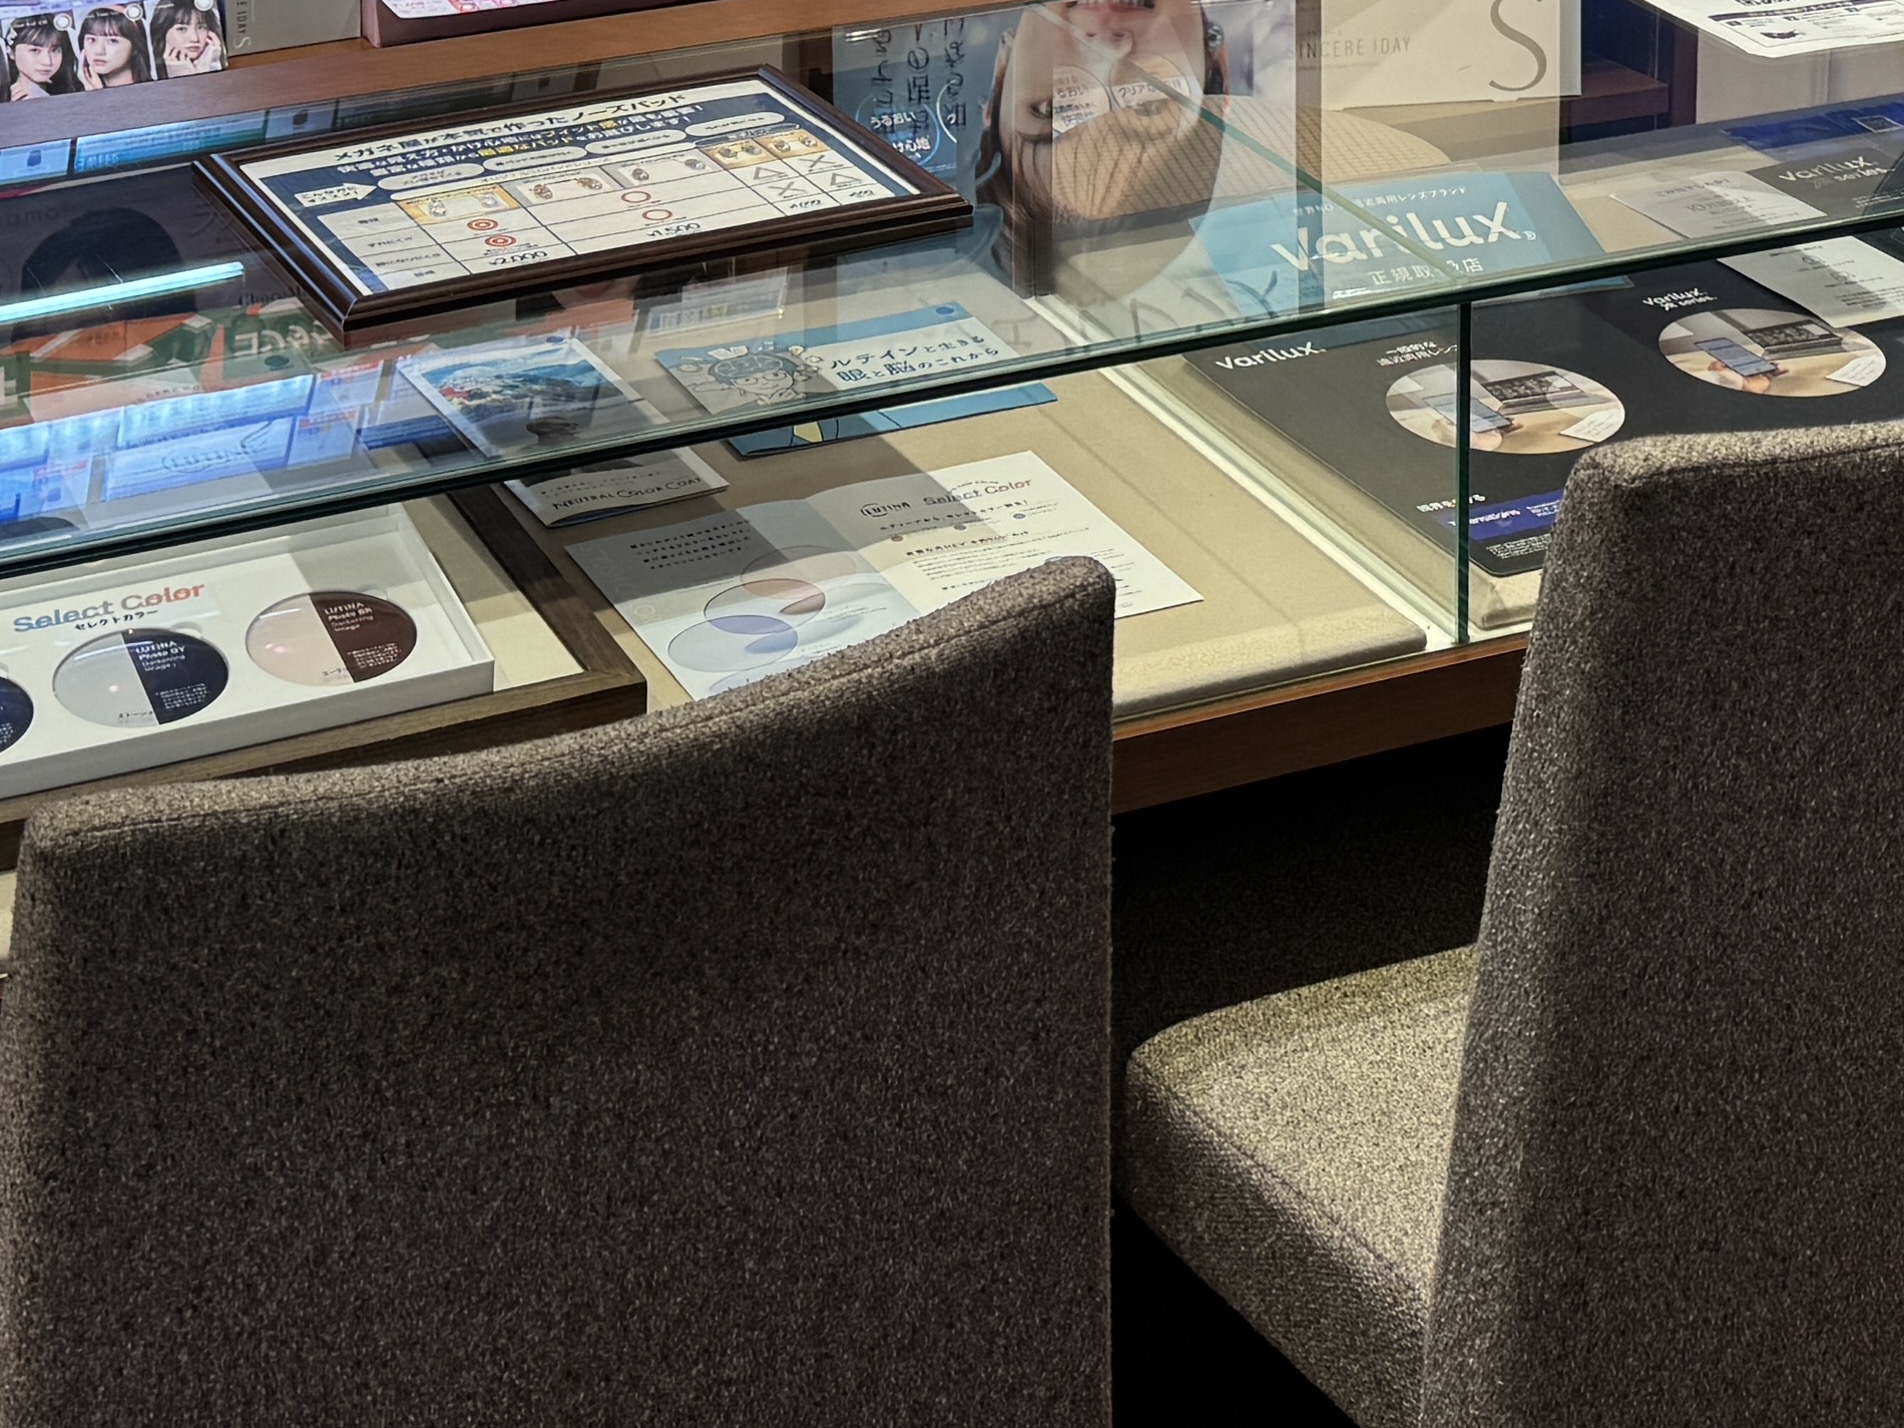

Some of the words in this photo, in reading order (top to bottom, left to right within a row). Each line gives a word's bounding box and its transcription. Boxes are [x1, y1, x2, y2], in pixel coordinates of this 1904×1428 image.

[827, 332, 986, 372] ルテインと生きる
[835, 346, 1000, 384] 眼と脳のこれから
[12, 599, 115, 634] Select
[127, 583, 206, 614] Color
[73, 608, 159, 632] セレクトカラー
